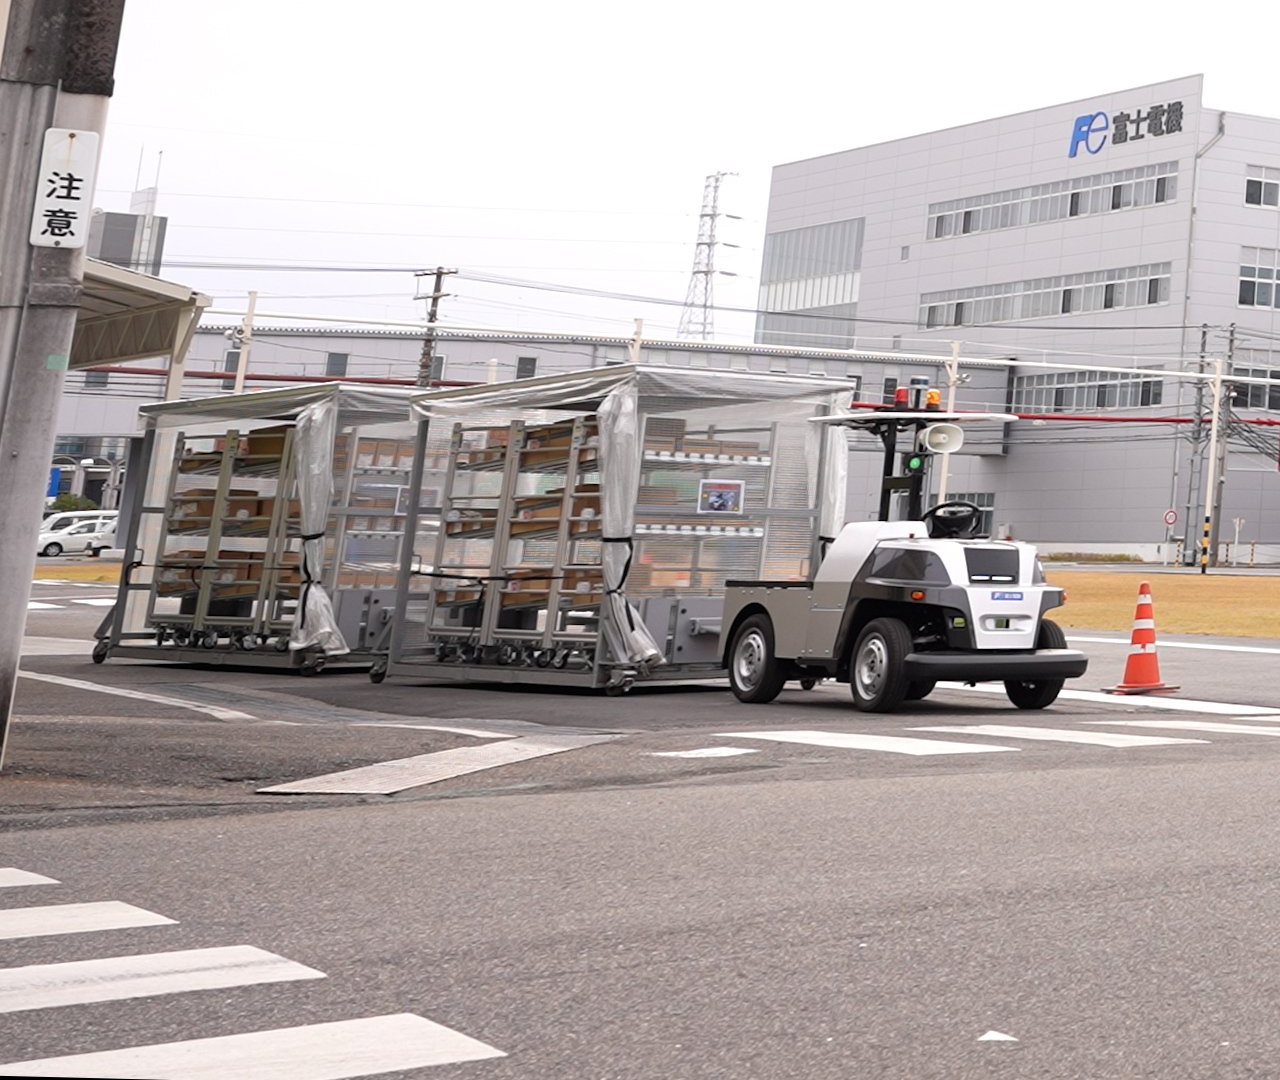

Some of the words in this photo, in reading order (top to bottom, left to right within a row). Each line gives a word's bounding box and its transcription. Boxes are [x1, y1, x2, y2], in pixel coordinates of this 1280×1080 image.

[1111, 101, 1184, 145] 富士電機
[40, 171, 84, 237] 注意
